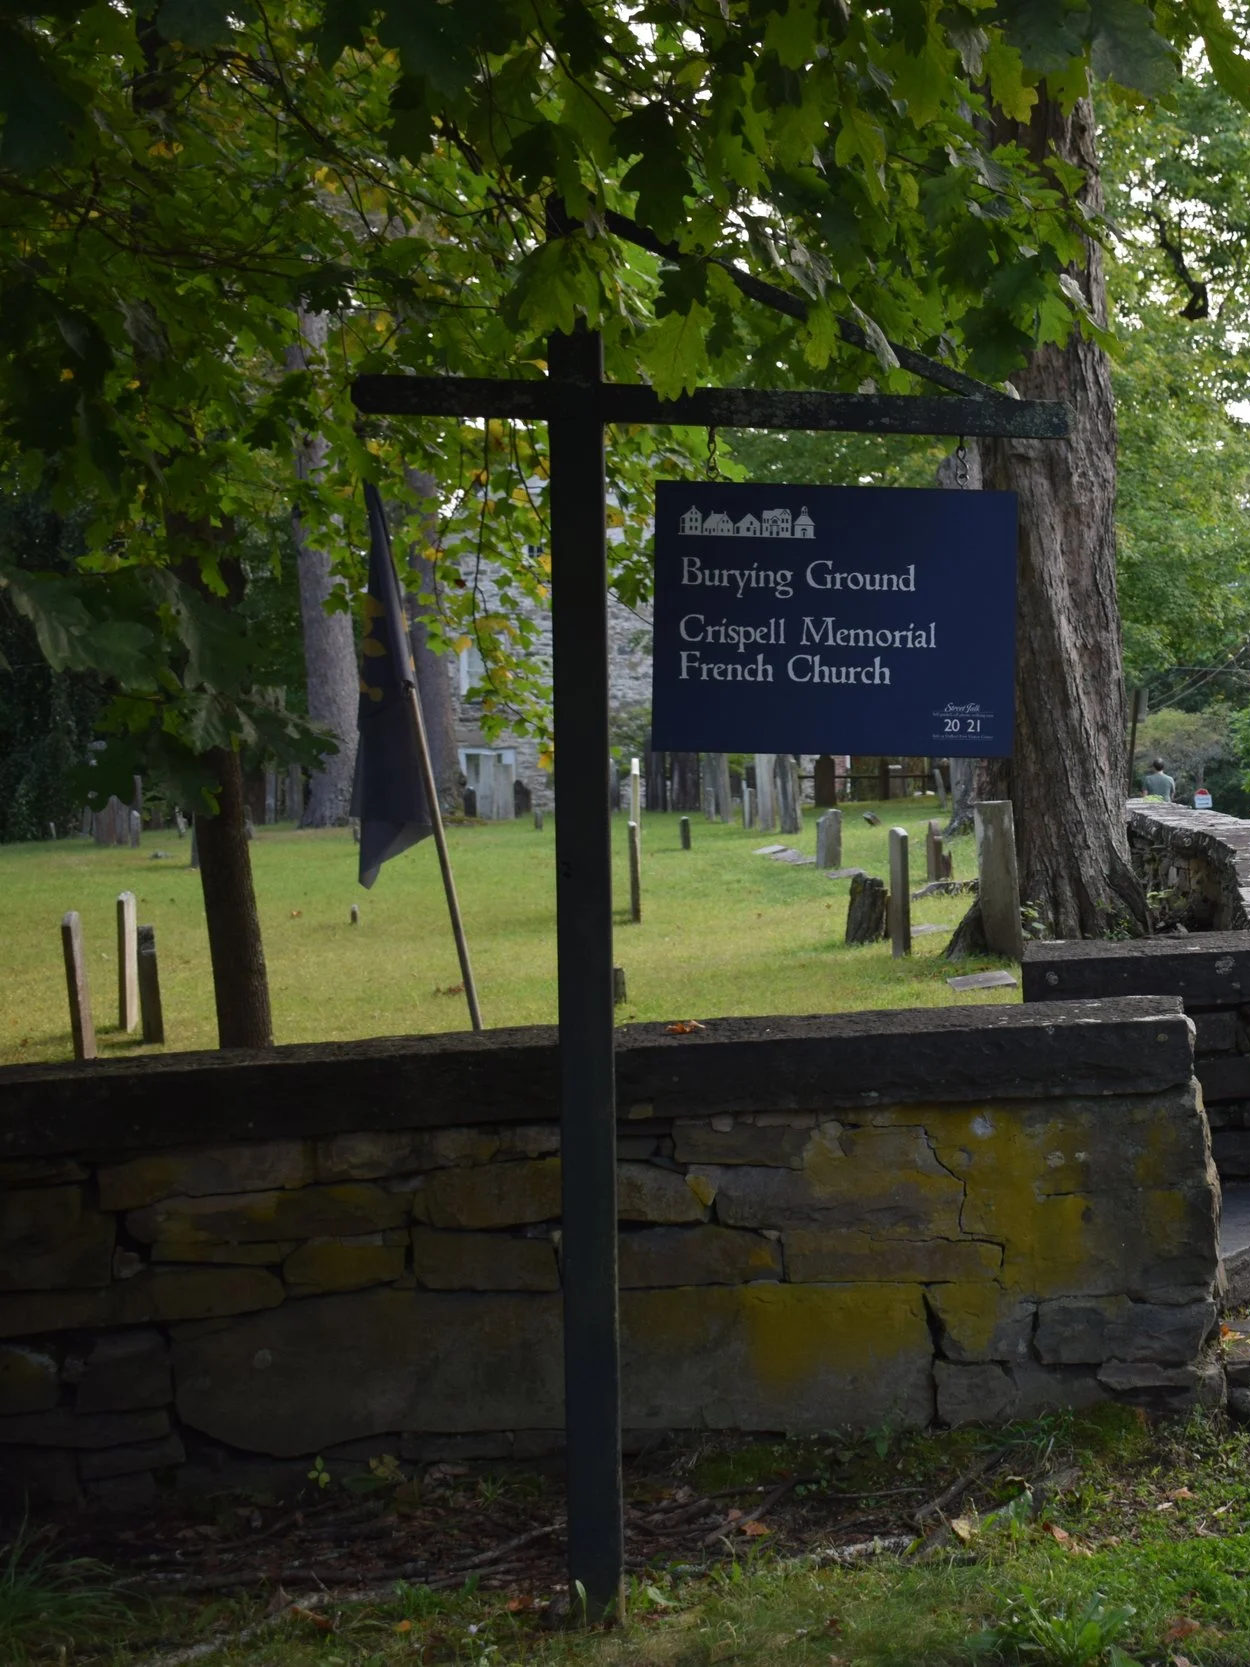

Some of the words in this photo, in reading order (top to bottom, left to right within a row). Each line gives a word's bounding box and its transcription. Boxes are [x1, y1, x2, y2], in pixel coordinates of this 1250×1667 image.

[681, 556, 794, 598] Burying
[806, 560, 916, 592] Ground
[679, 613, 786, 653] Crispell
[800, 616, 937, 648] Memorial
[678, 651, 774, 682] French
[787, 654, 892, 685] Church
[944, 719, 960, 732] 20
[967, 719, 981, 732] 21
